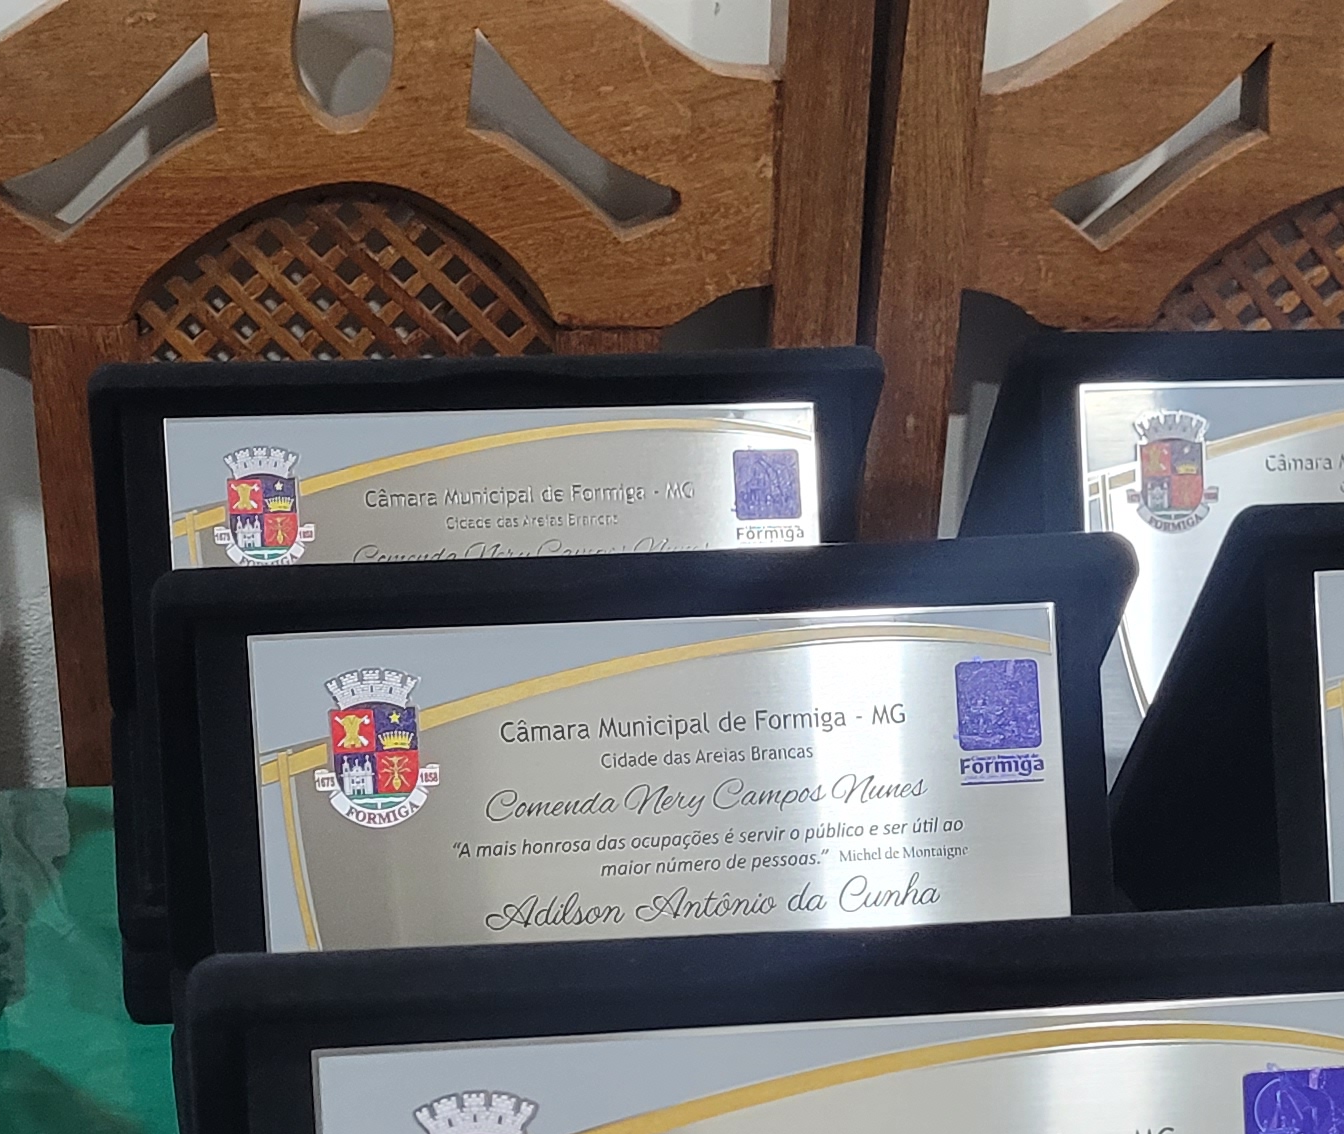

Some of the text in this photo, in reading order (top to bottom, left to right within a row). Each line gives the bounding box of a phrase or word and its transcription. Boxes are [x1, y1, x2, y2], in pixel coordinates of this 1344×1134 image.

[1264, 453, 1333, 473] Câmara
[959, 757, 1045, 777] Formiga
[346, 801, 419, 825] FORMIGA
[485, 871, 941, 931] Adilson Antônio da Cunha
